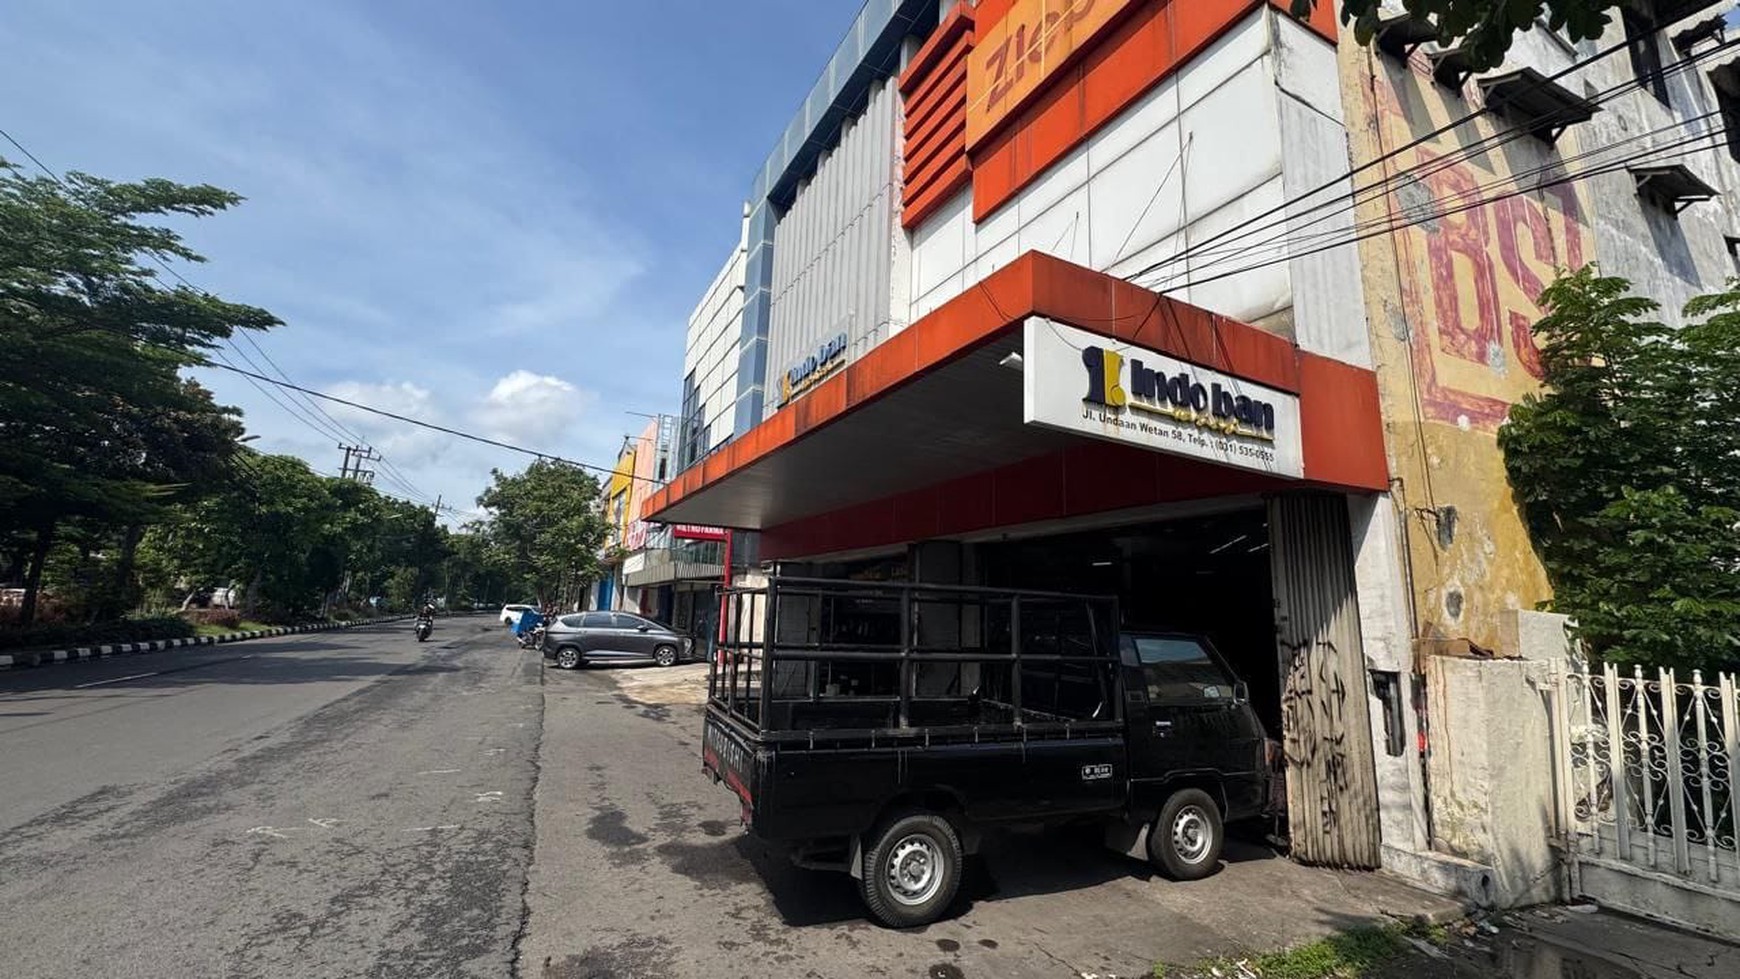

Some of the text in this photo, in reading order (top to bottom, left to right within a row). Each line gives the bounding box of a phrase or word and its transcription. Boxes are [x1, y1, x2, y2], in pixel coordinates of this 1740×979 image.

[1130, 358, 1207, 413] Indo
[1211, 382, 1275, 431] ban
[1082, 409, 1096, 421] Jl.
[1099, 411, 1137, 431] Undaan
[1139, 423, 1169, 438] Wetan
